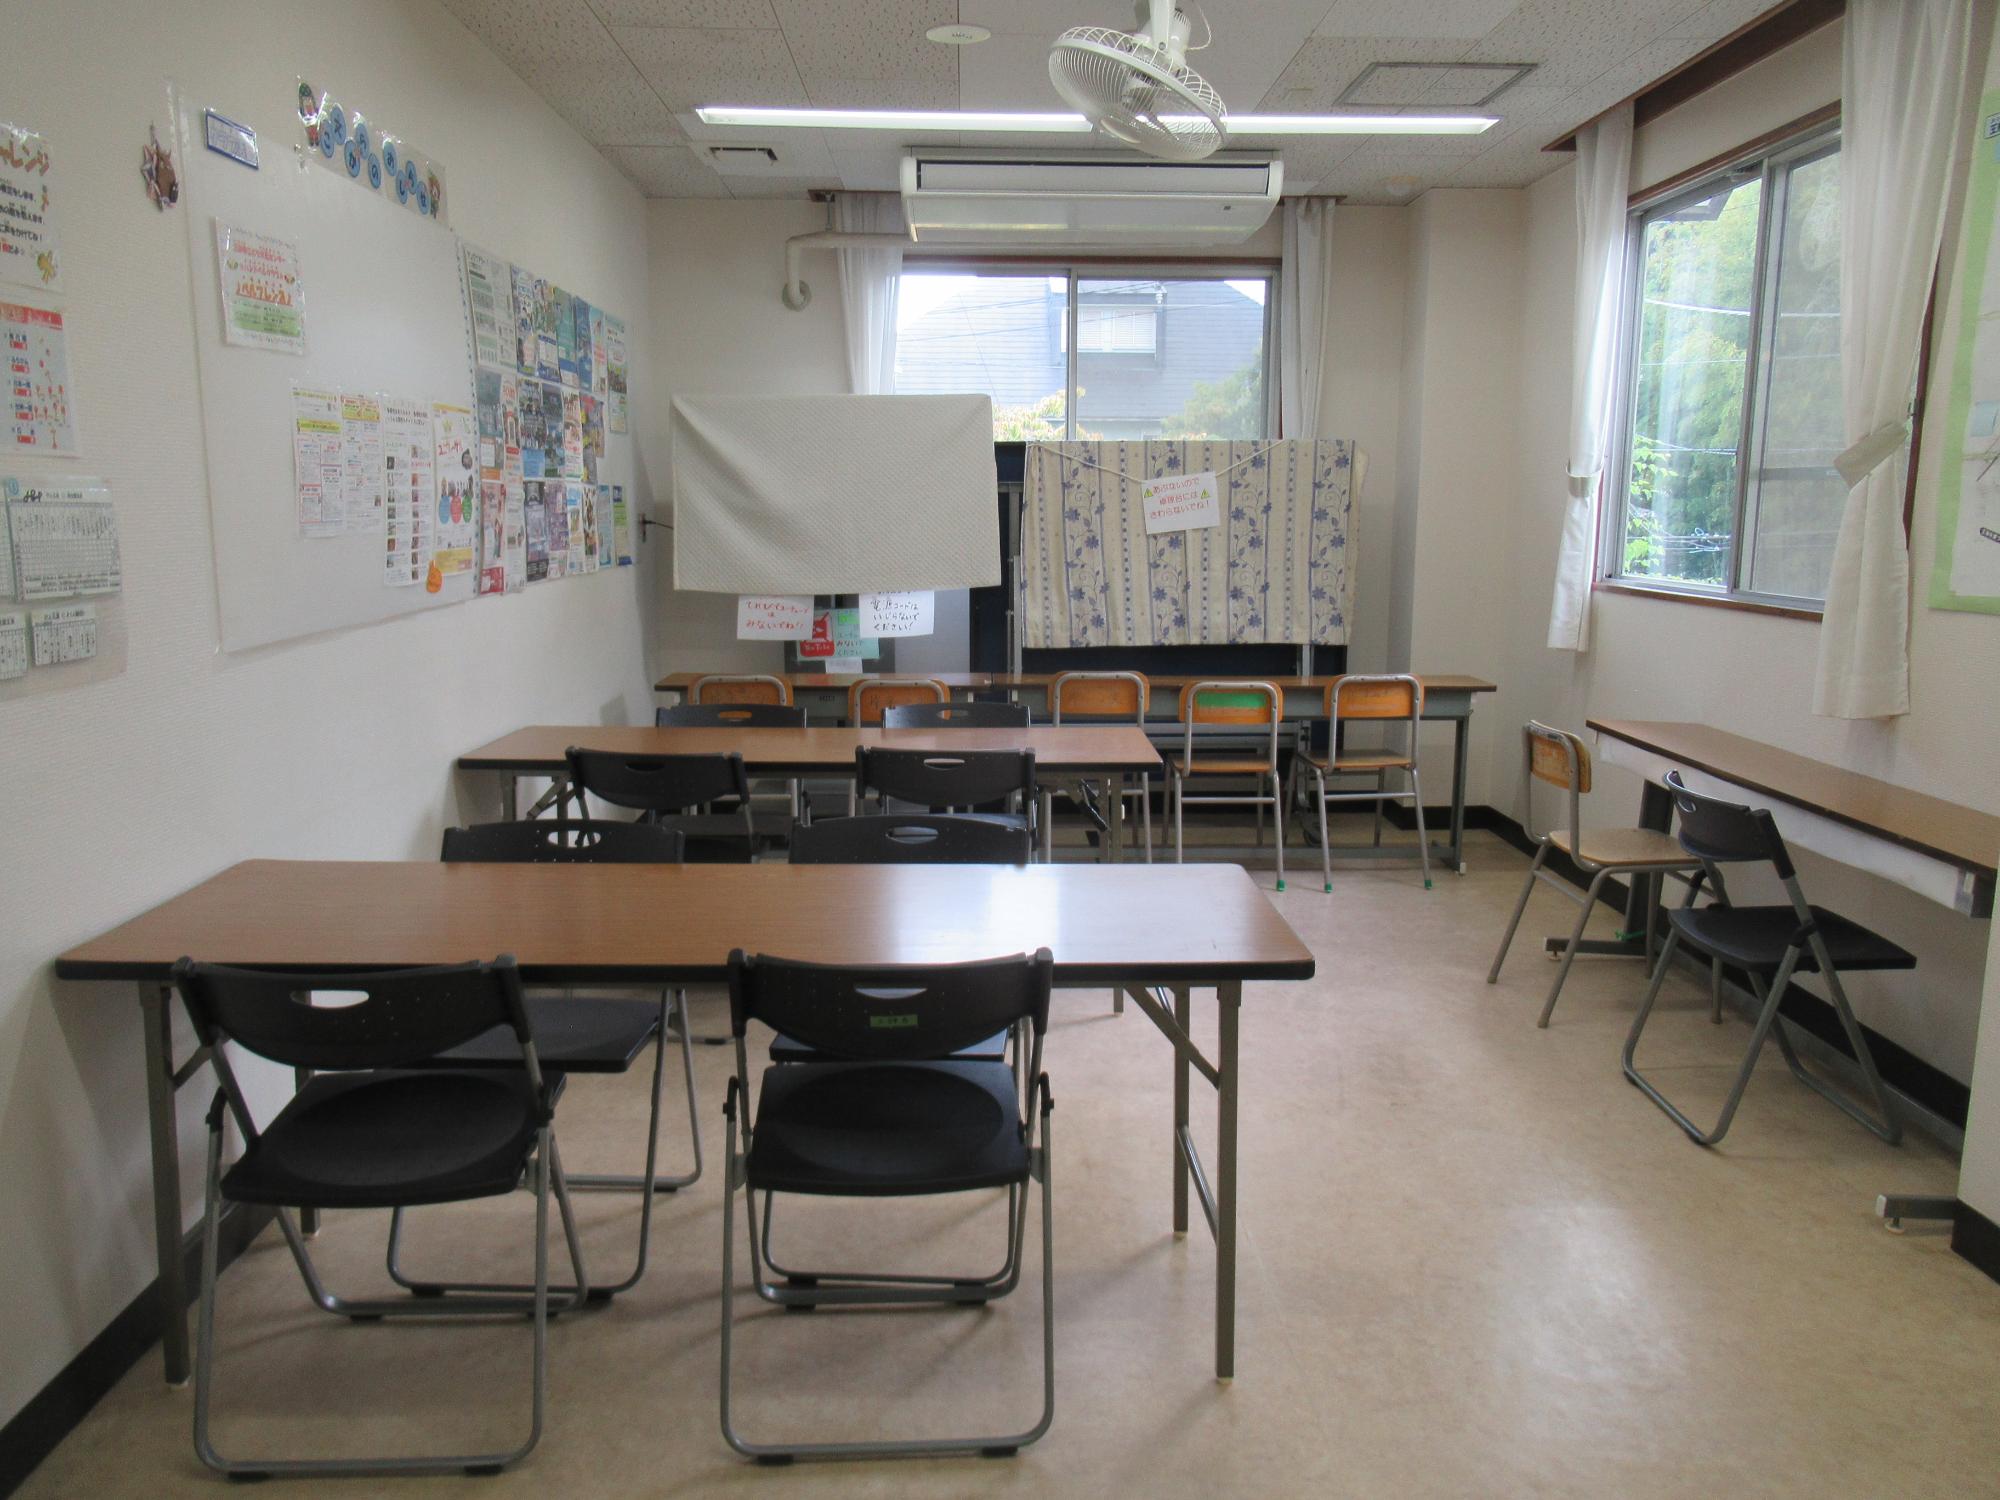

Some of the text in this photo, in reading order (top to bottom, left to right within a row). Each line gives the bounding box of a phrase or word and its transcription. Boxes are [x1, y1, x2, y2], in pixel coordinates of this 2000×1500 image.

[1153, 478, 1199, 494] あぶないので
